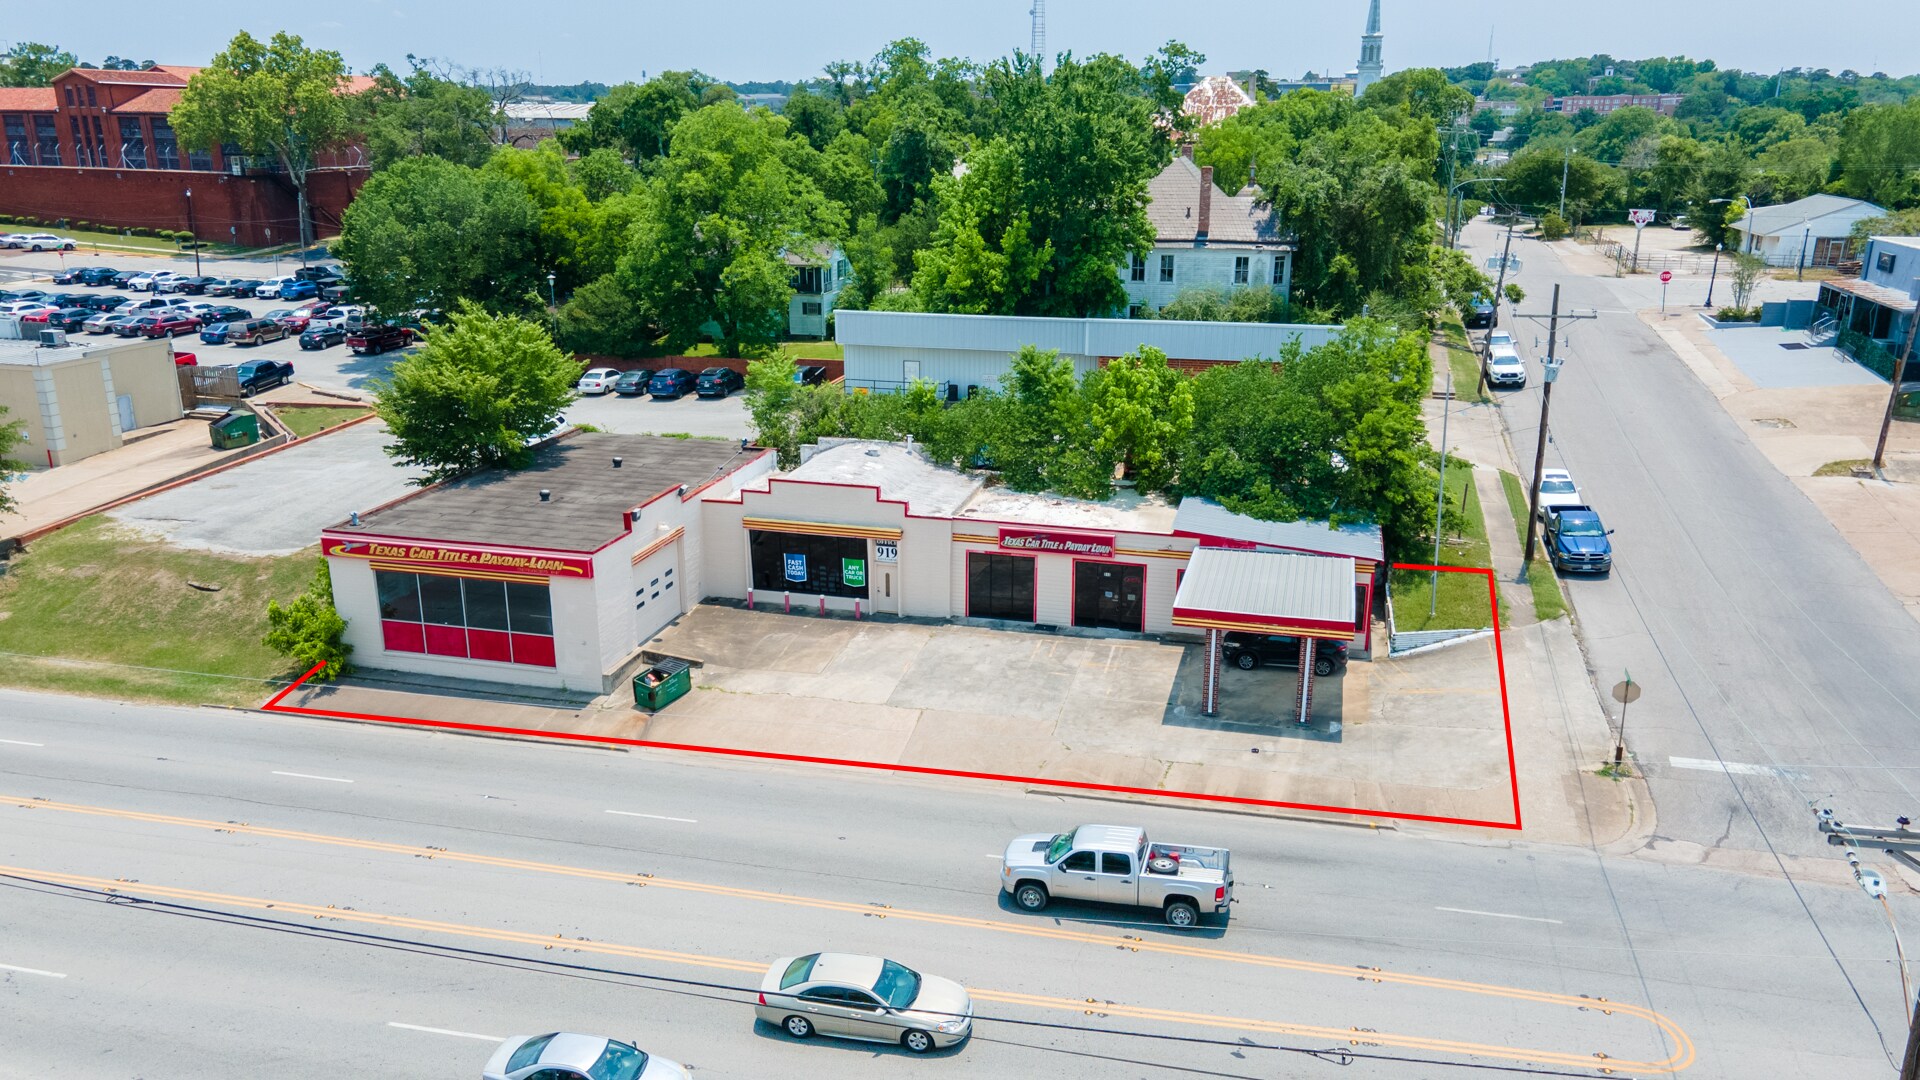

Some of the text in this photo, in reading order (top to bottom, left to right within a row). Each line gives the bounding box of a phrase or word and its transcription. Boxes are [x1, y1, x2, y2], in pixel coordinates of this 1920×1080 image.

[368, 543, 407, 558] TEXAS
[408, 546, 436, 561] CAR
[437, 549, 470, 563] TITLE
[469, 555, 478, 564] &
[878, 547, 898, 558] 919
[1004, 536, 1025, 546] TEXAS
[1025, 538, 1040, 548] CAR
[1041, 539, 1059, 549] TITLE
[1064, 541, 1092, 552] PAYDAY
[1091, 543, 1111, 554] LOAN
